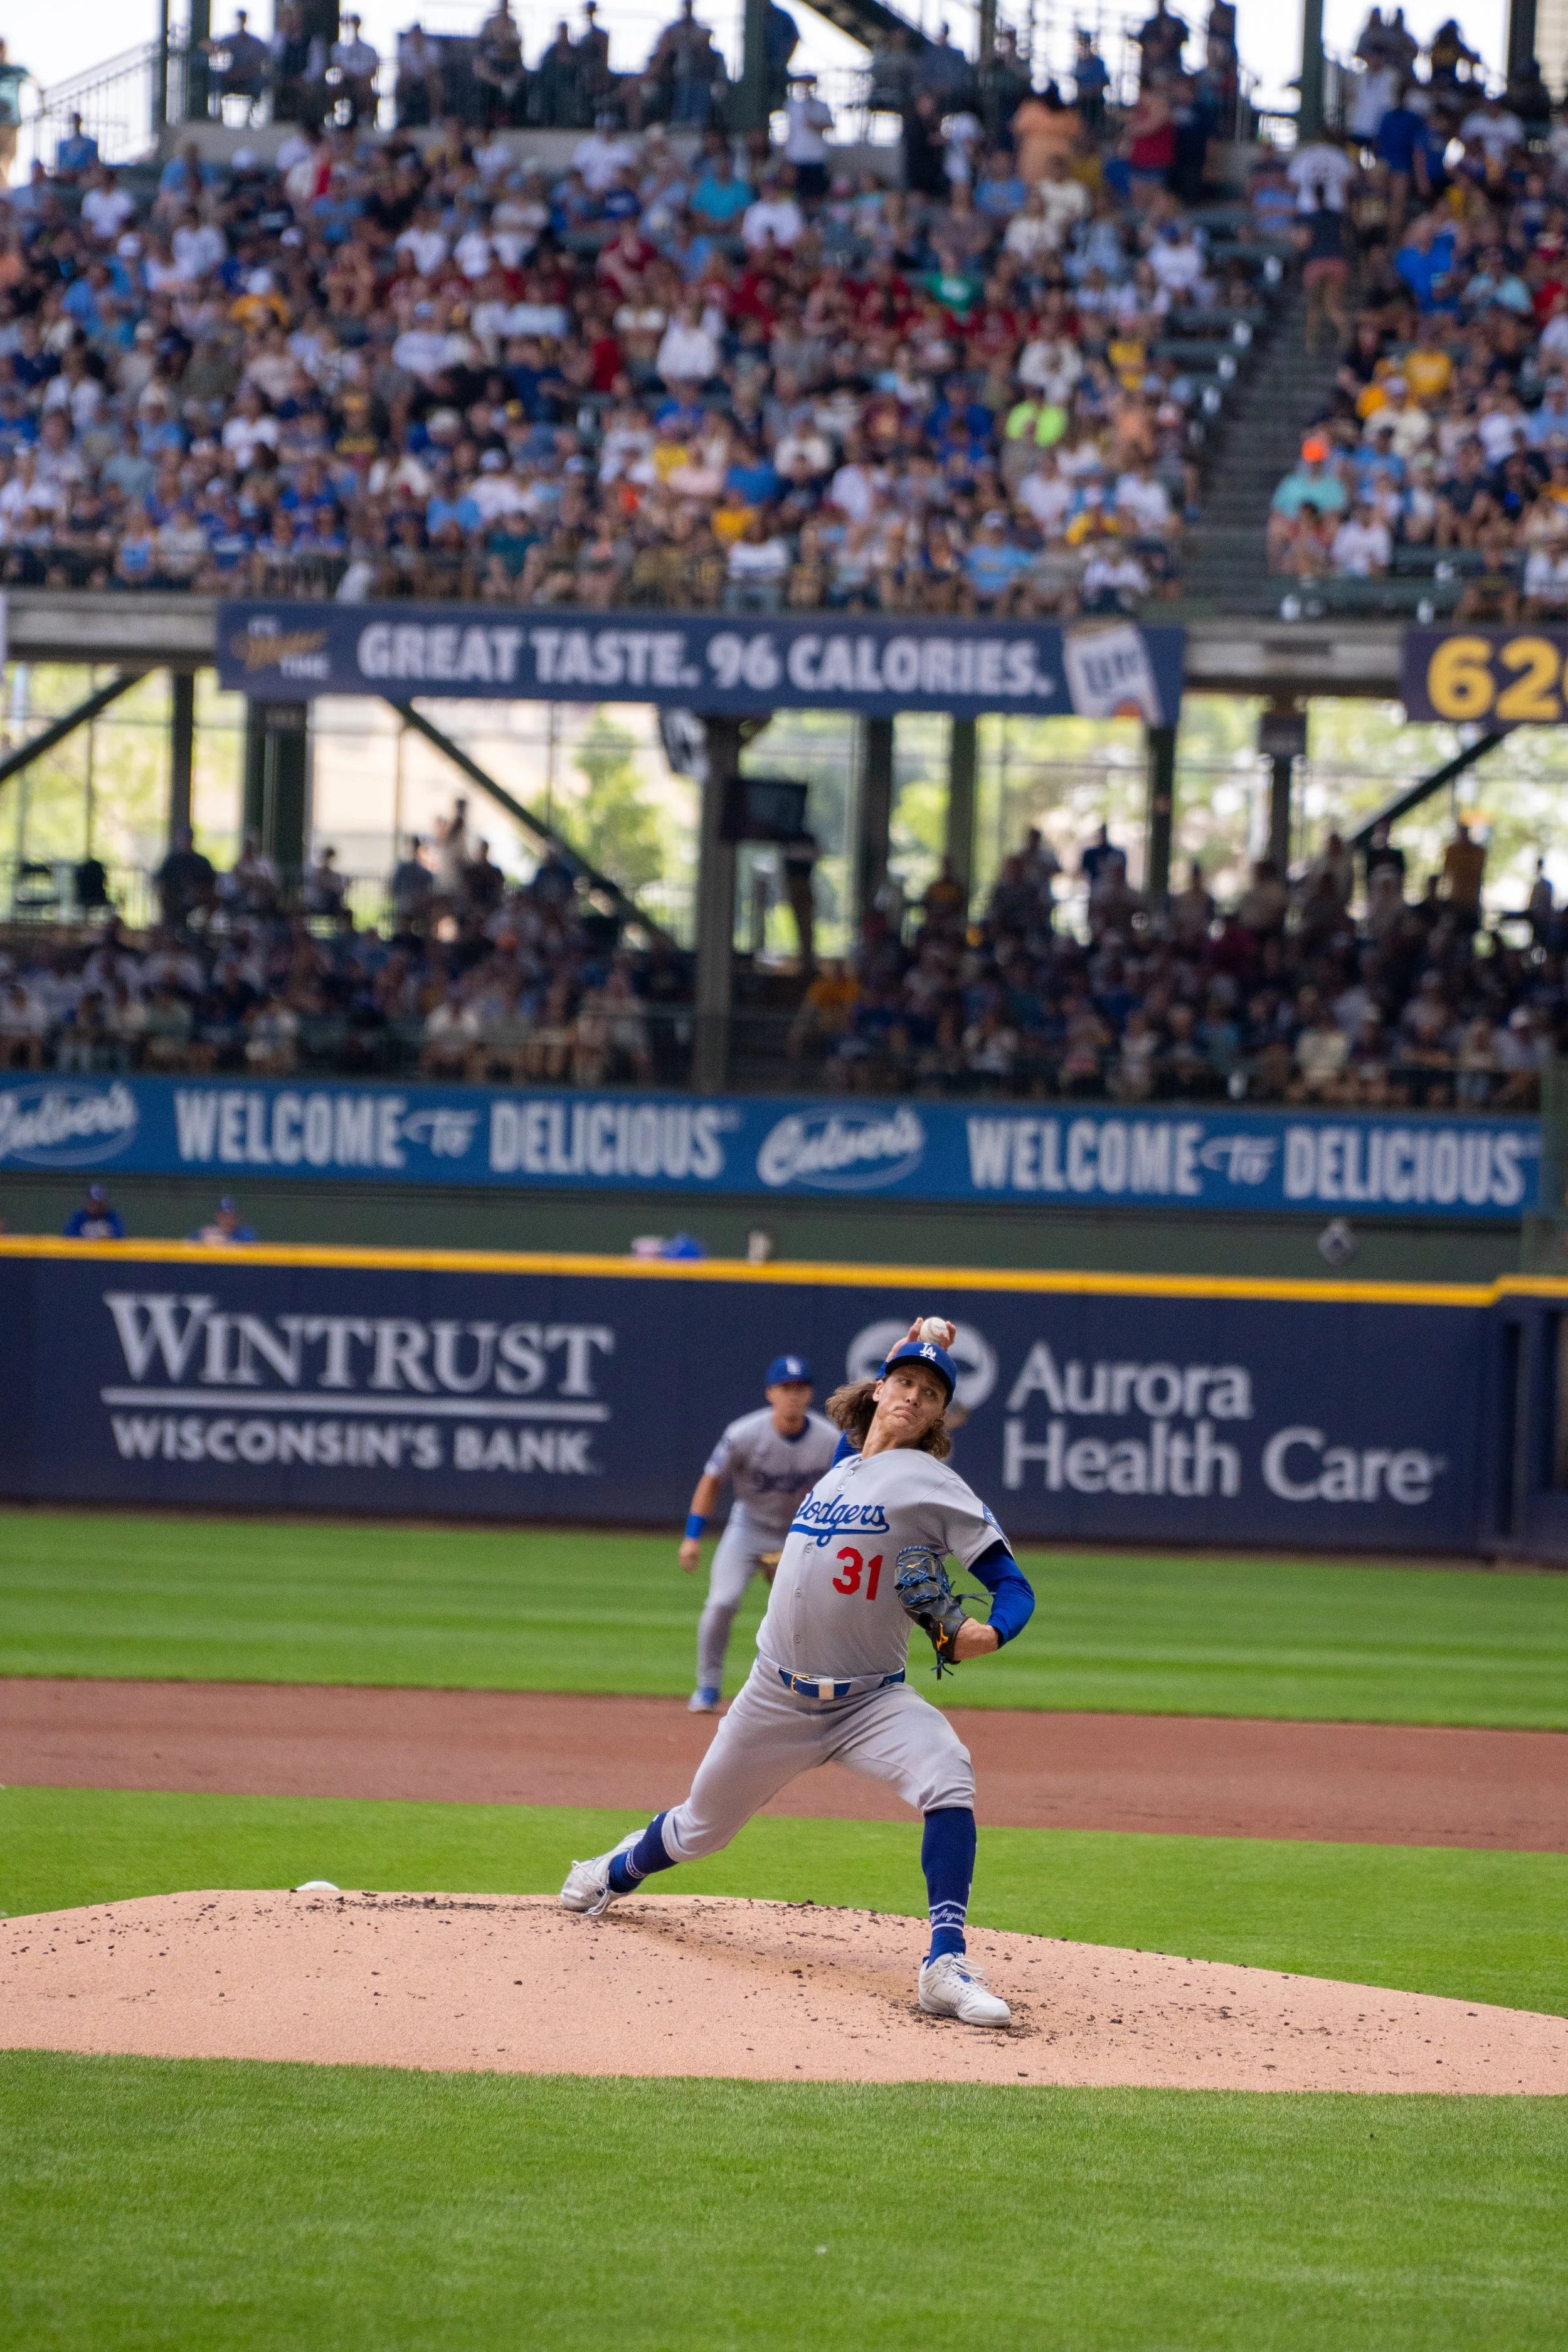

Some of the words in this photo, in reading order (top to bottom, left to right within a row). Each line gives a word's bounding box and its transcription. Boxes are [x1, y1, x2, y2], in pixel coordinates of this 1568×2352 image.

[357, 623, 524, 681] GREAT
[531, 628, 700, 686] TASTE.
[707, 632, 781, 689] 96
[788, 634, 1053, 696] CALORIES.
[1426, 635, 1568, 720] 62
[174, 1090, 407, 1168] WELCOME
[489, 1100, 726, 1180] DELICIOUS
[967, 1116, 1203, 1196] WELCOME
[1283, 1125, 1525, 1205] DELICIOUS
[102, 1291, 615, 1397] WINTRUST
[1007, 1341, 1253, 1421] Aurora
[111, 1414, 440, 1470] WISCONSIN'S
[453, 1426, 593, 1475] BANK
[1003, 1419, 1240, 1497] Health
[1261, 1426, 1434, 1505] Care
[832, 1547, 882, 1600] 31
